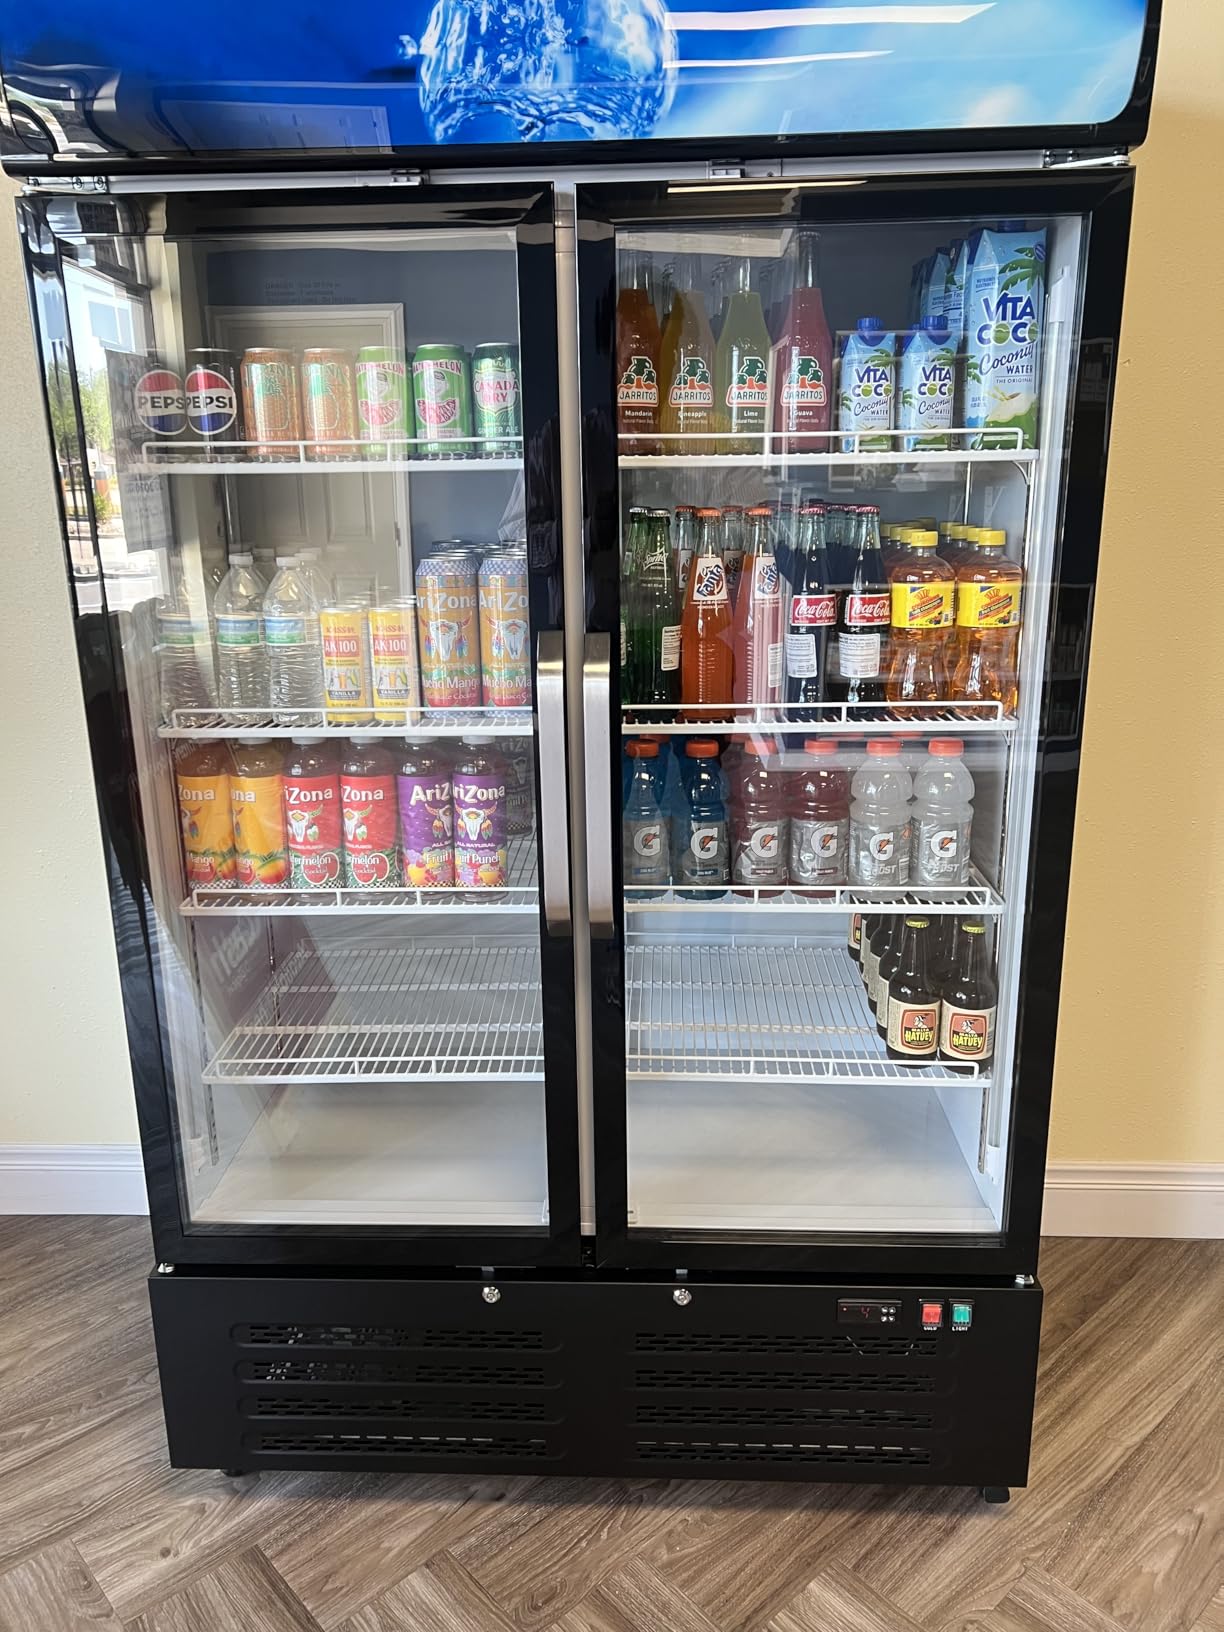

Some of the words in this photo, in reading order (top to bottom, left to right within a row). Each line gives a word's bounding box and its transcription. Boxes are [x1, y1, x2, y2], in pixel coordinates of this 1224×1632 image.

[982, 291, 1035, 321] VITA
[977, 321, 1038, 345] COCO
[855, 365, 889, 383] VITA
[921, 364, 953, 382] VITA
[1006, 364, 1033, 374] WATER
[474, 380, 520, 393] CANADA
[784, 390, 823, 400] JARRITOS
[851, 383, 893, 397] COCO
[917, 382, 954, 396] COCO
[138, 395, 186, 409] PEPS
[482, 392, 508, 403] DRY
[619, 391, 657, 400] JARRITOS
[673, 391, 711, 401] JARRITOS
[731, 391, 768, 401] JARRITOS
[696, 564, 723, 597] Fanta
[795, 598, 834, 618] Coca-Cola
[852, 598, 890, 618] Coca-Cola
[633, 824, 661, 857] G
[690, 827, 718, 859] G
[750, 826, 779, 858] G
[810, 825, 838, 858] G
[869, 831, 894, 861] G
[930, 830, 957, 858] G
[426, 849, 449, 865] Fruit
[905, 1030, 933, 1042] HATUEY
[953, 1034, 983, 1048] HATUEY
